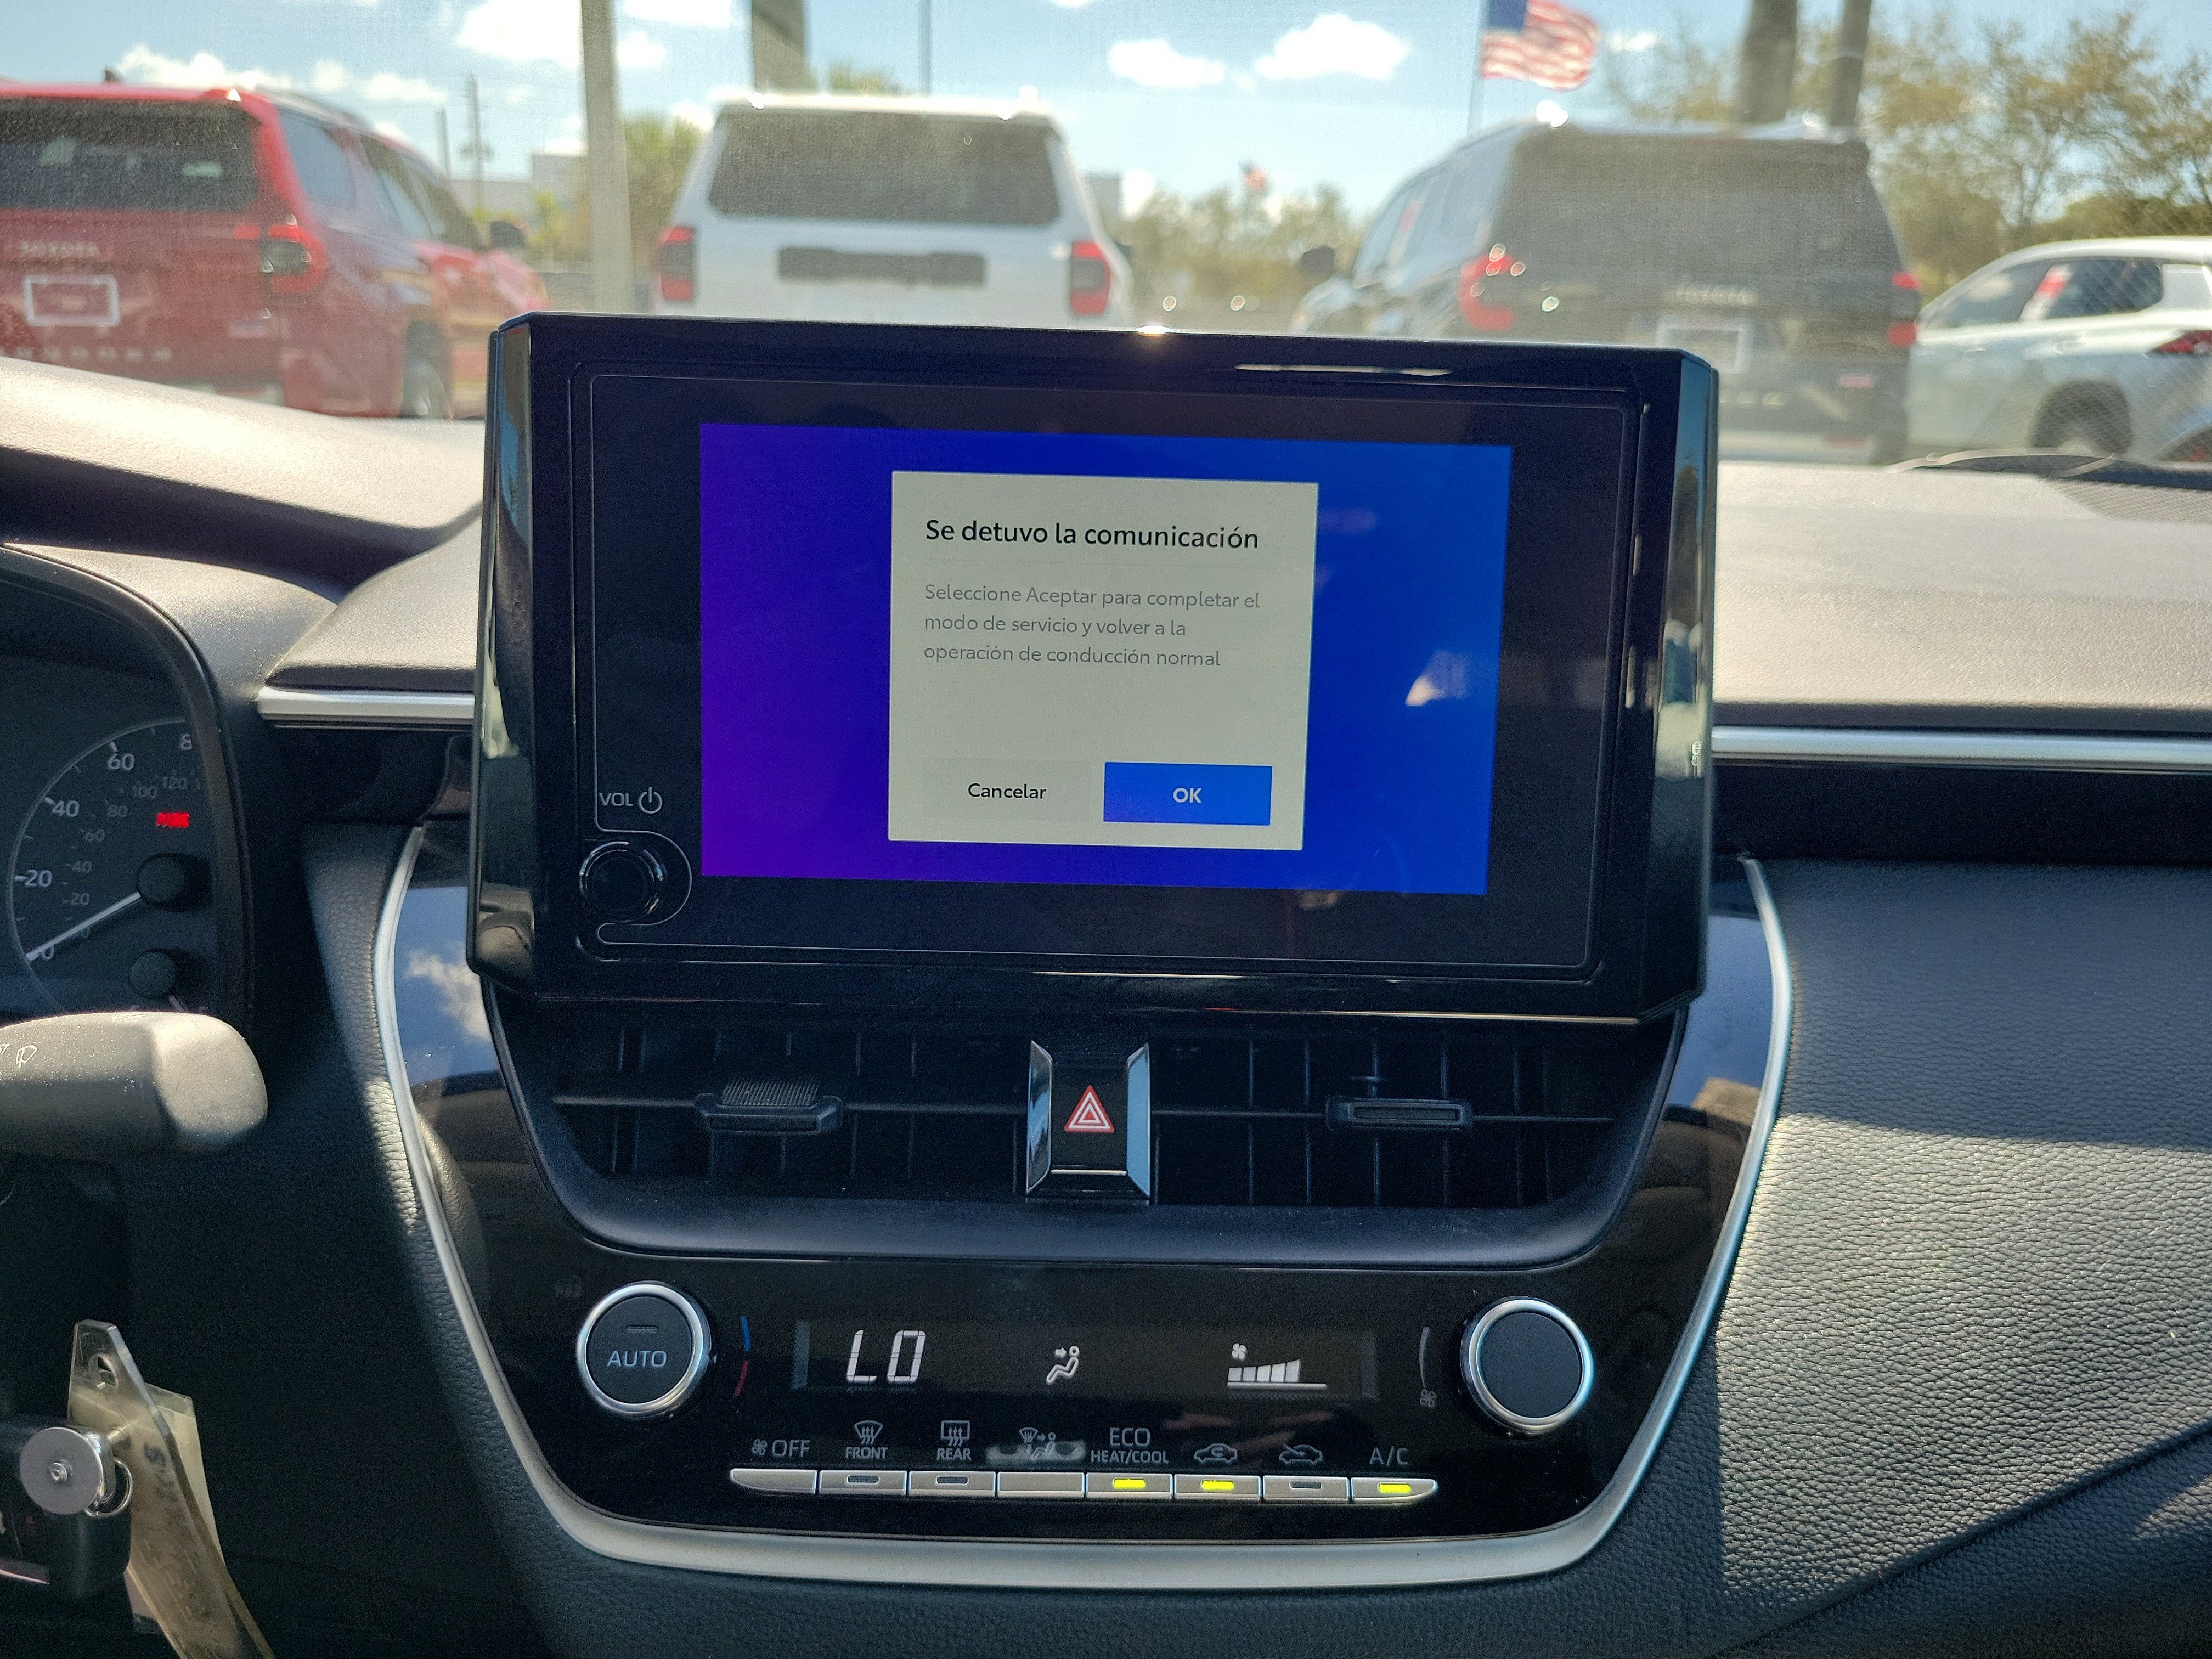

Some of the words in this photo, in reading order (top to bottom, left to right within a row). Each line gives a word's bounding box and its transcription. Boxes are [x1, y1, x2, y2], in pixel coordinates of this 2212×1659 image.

[926, 520, 955, 540] Se
[962, 520, 1048, 543] detuvo
[1055, 522, 1076, 544] la
[1084, 526, 1258, 549] comunicación
[924, 584, 1022, 602] Seleccione
[1026, 587, 1097, 607] Aceptar
[1102, 592, 1141, 608] para
[1147, 591, 1239, 610] completar
[1244, 592, 1260, 608] el
[924, 614, 978, 630] modo
[983, 615, 1006, 631] de
[1011, 617, 1077, 632] servicio
[1082, 622, 1092, 637] y
[1096, 618, 1151, 635] volver
[1154, 624, 1164, 635] a
[1171, 619, 1186, 635] la
[924, 645, 1013, 663] operación
[1019, 645, 1041, 661] de
[1047, 647, 1150, 664] conducción
[1156, 650, 1220, 666] normal
[108, 753, 136, 770] 60
[132, 785, 158, 798] 100
[162, 777, 188, 789] 120
[968, 783, 1047, 799] Cancelar
[599, 792, 633, 806] VOL
[1172, 787, 1202, 804] OK
[52, 800, 80, 818] 40
[108, 804, 128, 818] 80
[84, 830, 105, 842] 60
[71, 861, 92, 873] 40
[25, 870, 52, 888] 20
[70, 892, 90, 906] 20
[607, 1350, 667, 1368] AUTO
[1109, 1427, 1151, 1446] ECO
[771, 1439, 811, 1458] OFF
[845, 1446, 888, 1460] FRONT
[936, 1448, 972, 1460] REAR
[1091, 1449, 1169, 1464] HEAT/COOL
[1369, 1445, 1408, 1466] A/C
